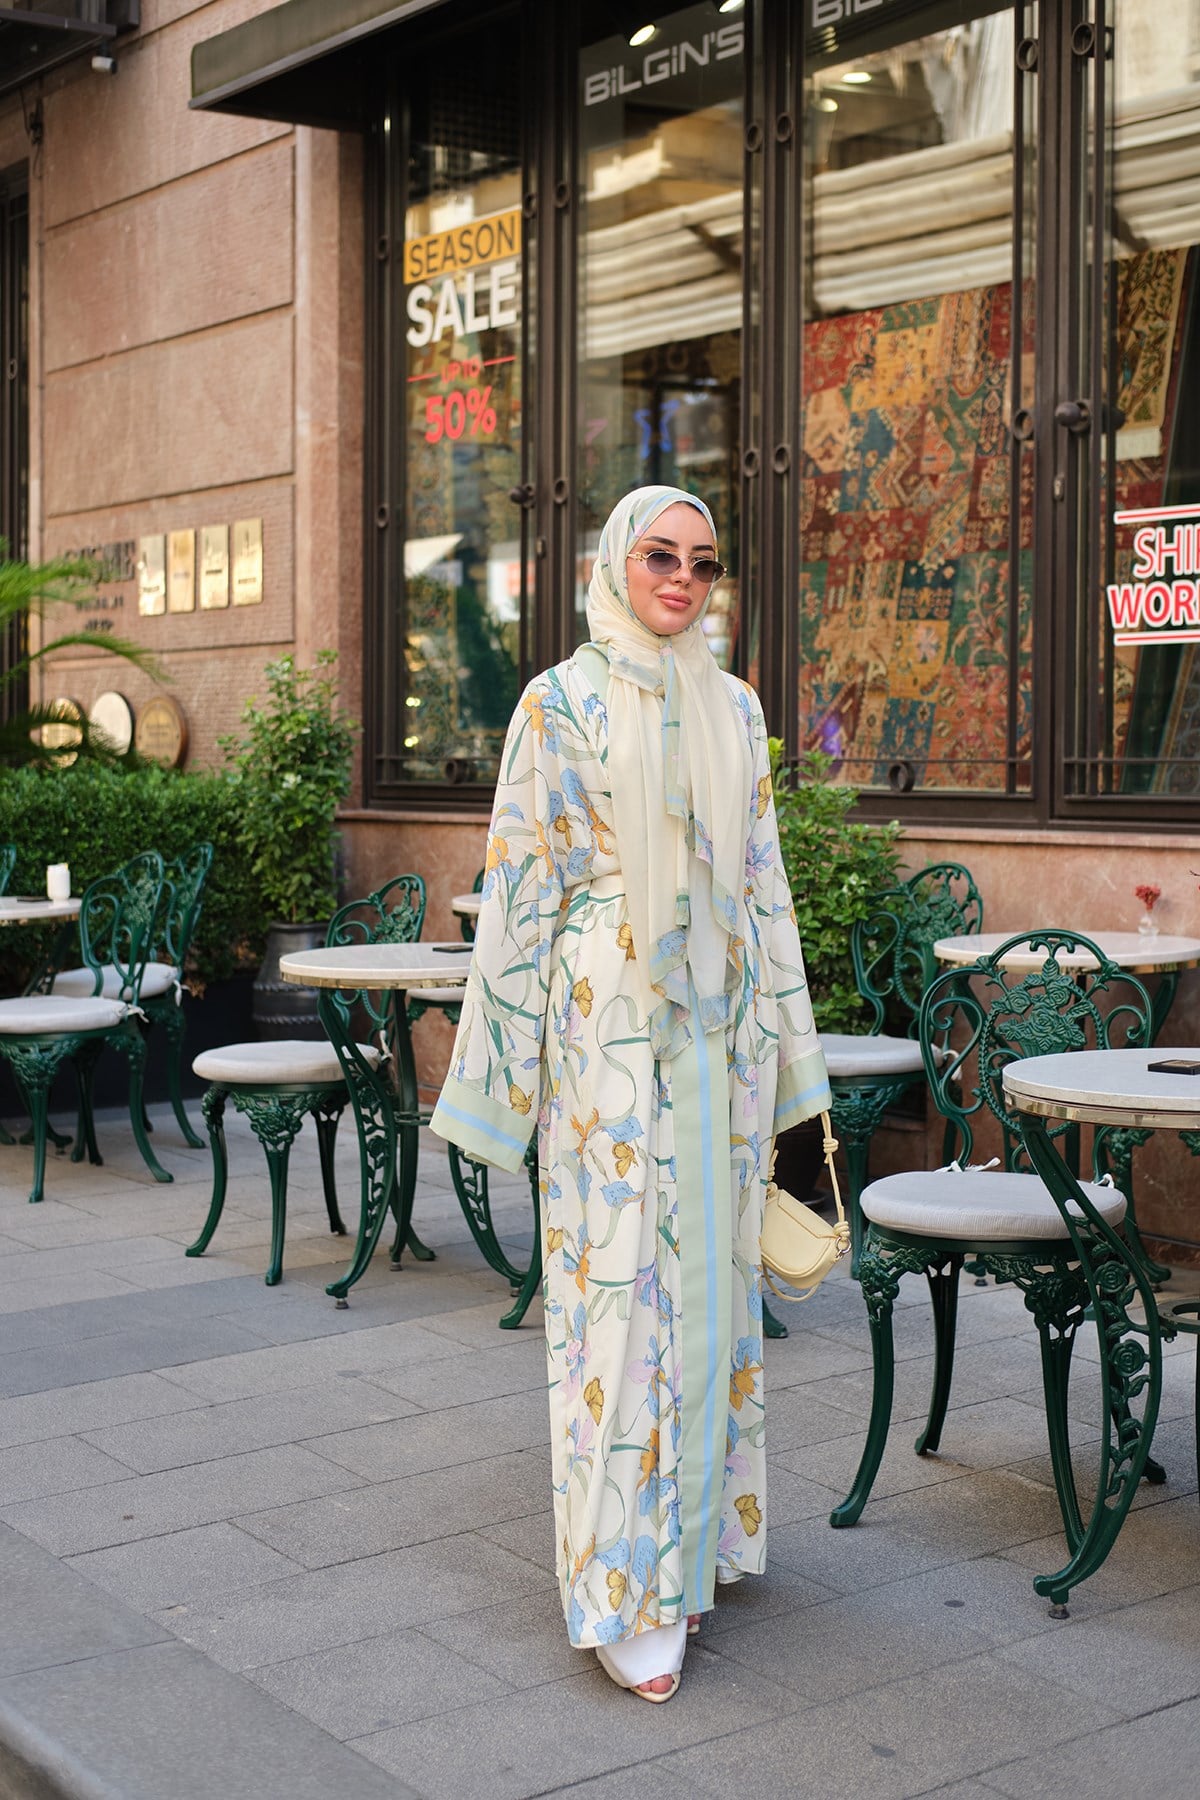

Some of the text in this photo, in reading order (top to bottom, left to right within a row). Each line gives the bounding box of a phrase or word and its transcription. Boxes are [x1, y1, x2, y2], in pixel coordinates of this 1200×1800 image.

[410, 216, 515, 277] SEASON
[406, 261, 517, 347] SALE
[425, 386, 497, 443] 50%
[1133, 525, 1200, 578] SHI
[1107, 580, 1200, 628] WOR
